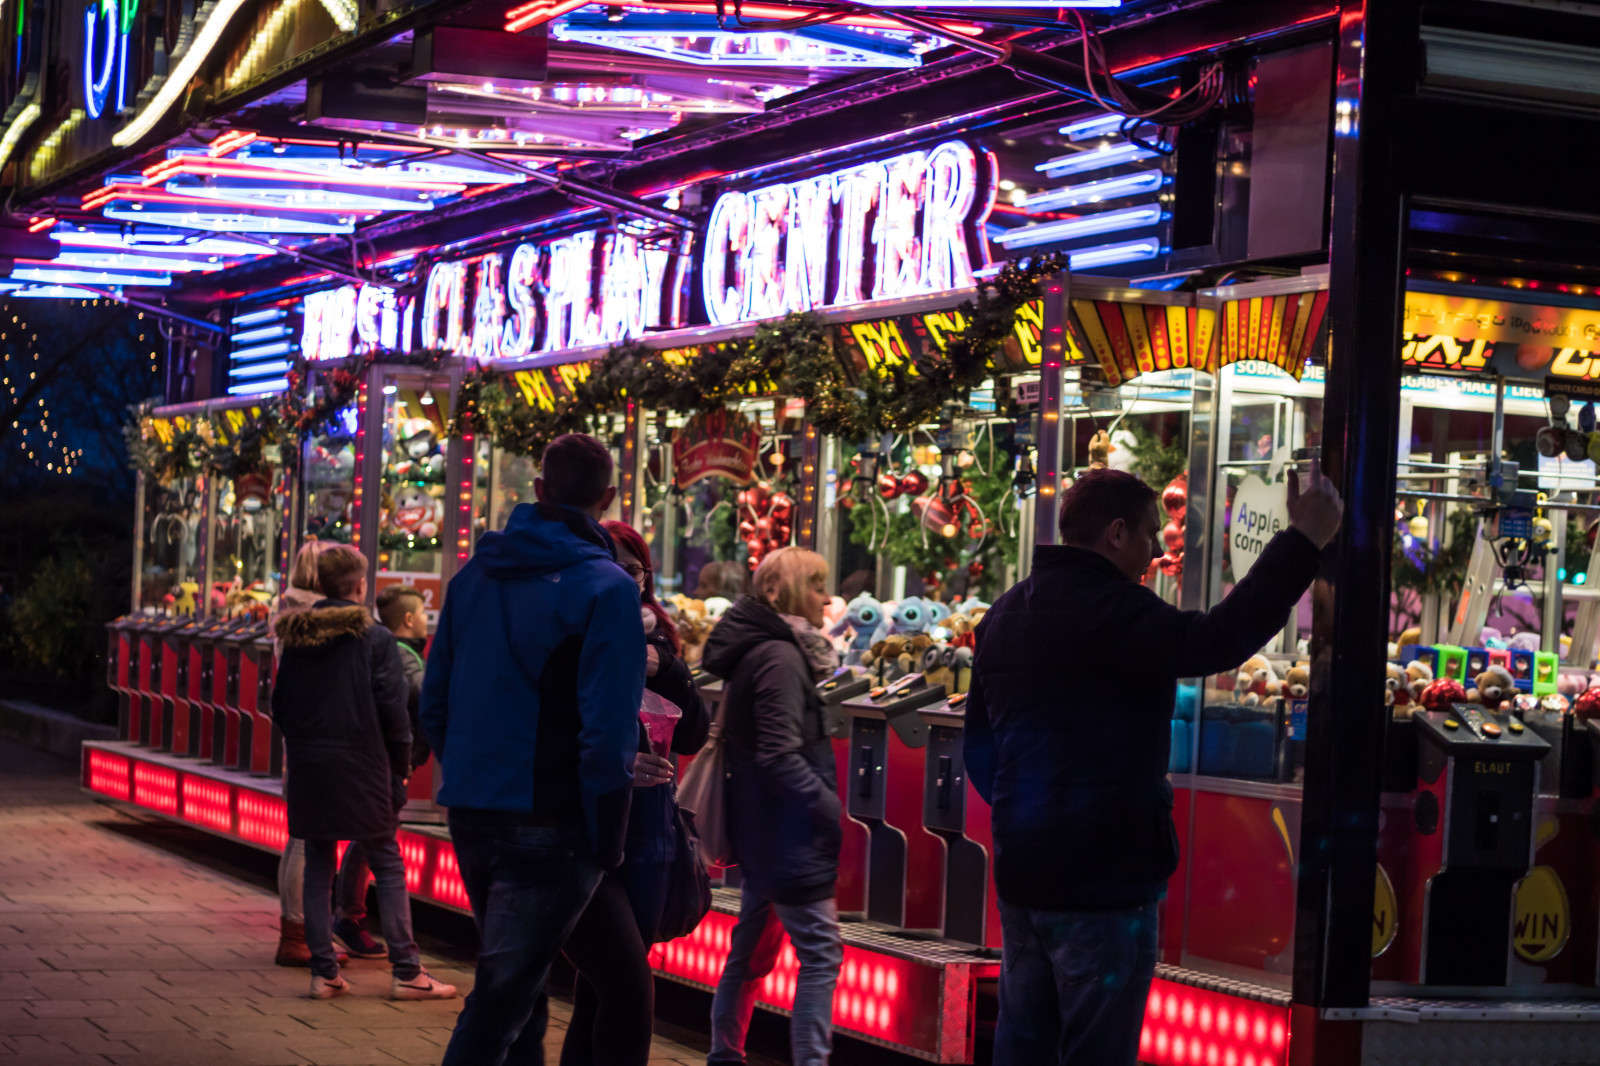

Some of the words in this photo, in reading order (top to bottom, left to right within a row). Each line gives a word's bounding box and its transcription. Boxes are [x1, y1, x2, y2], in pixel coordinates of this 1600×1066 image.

[703, 140, 977, 325] CENTER
[1237, 502, 1280, 534] Apple
[1475, 761, 1511, 774] ELAUT
[1514, 913, 1558, 939] WIN
